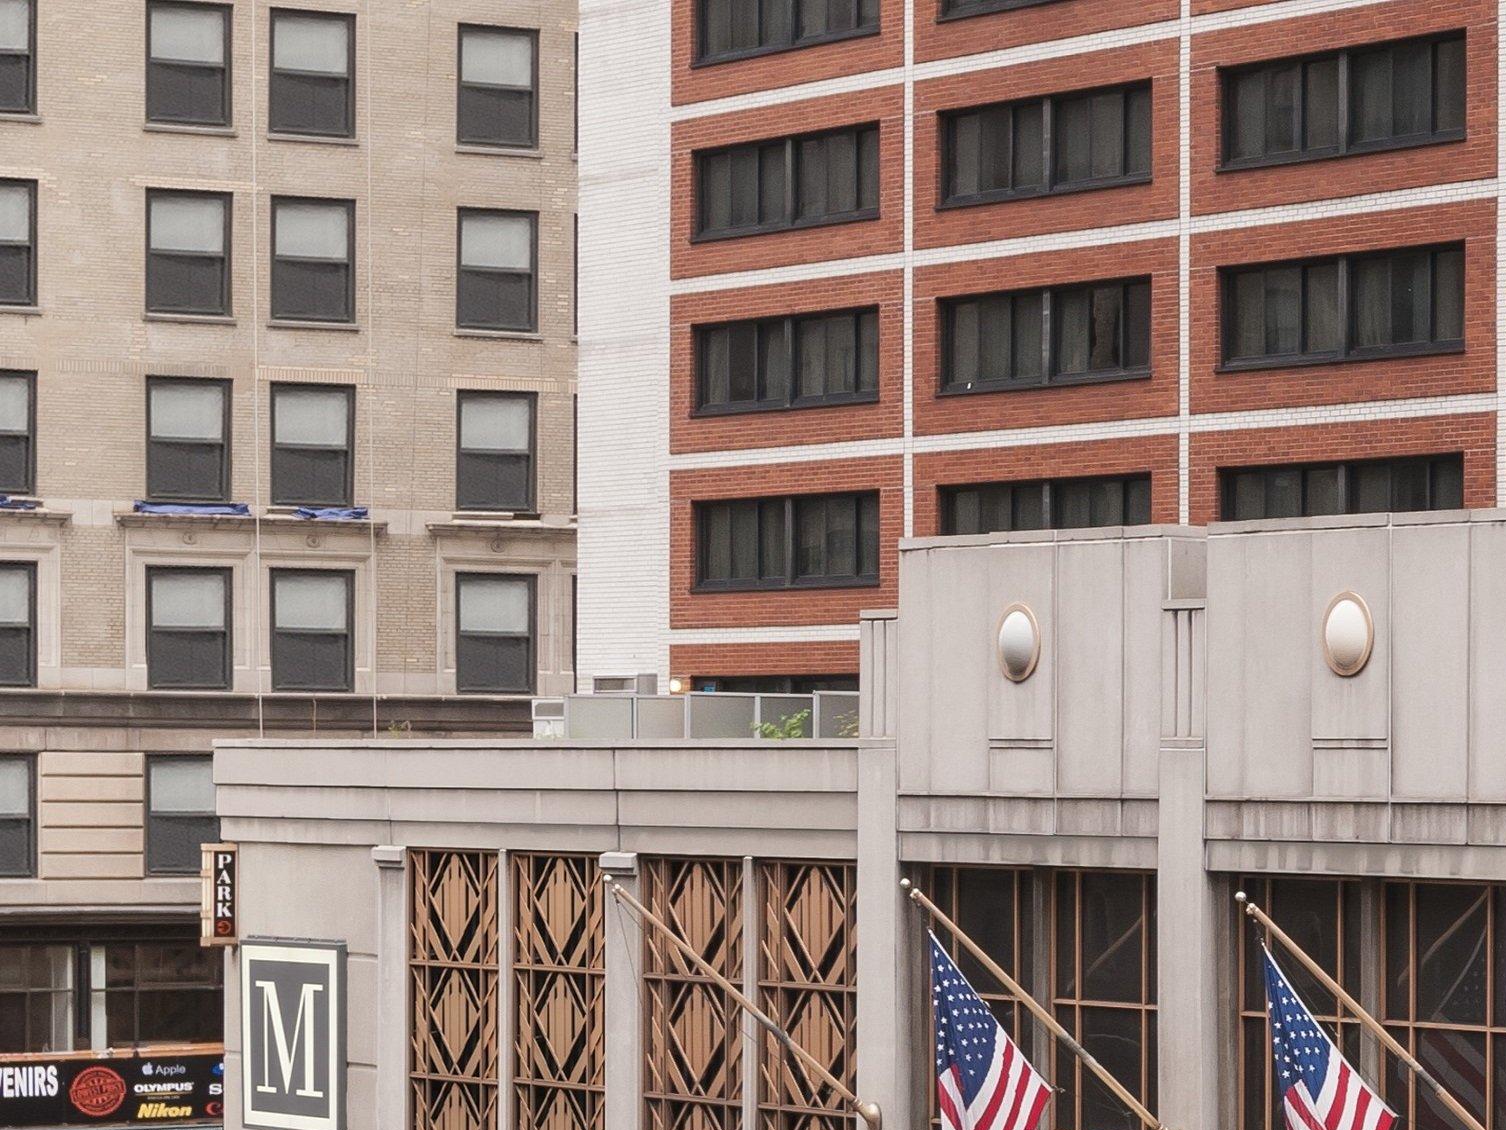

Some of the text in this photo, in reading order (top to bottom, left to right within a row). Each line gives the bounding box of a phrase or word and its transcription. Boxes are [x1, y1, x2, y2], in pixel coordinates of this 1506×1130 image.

[216, 853, 233, 917] PARK
[255, 980, 324, 1098] M
[0, 1065, 59, 1098] ENIRS
[155, 1064, 186, 1076] Apple
[133, 1082, 194, 1093] OLYMPUS
[137, 1102, 192, 1118] Nikon
